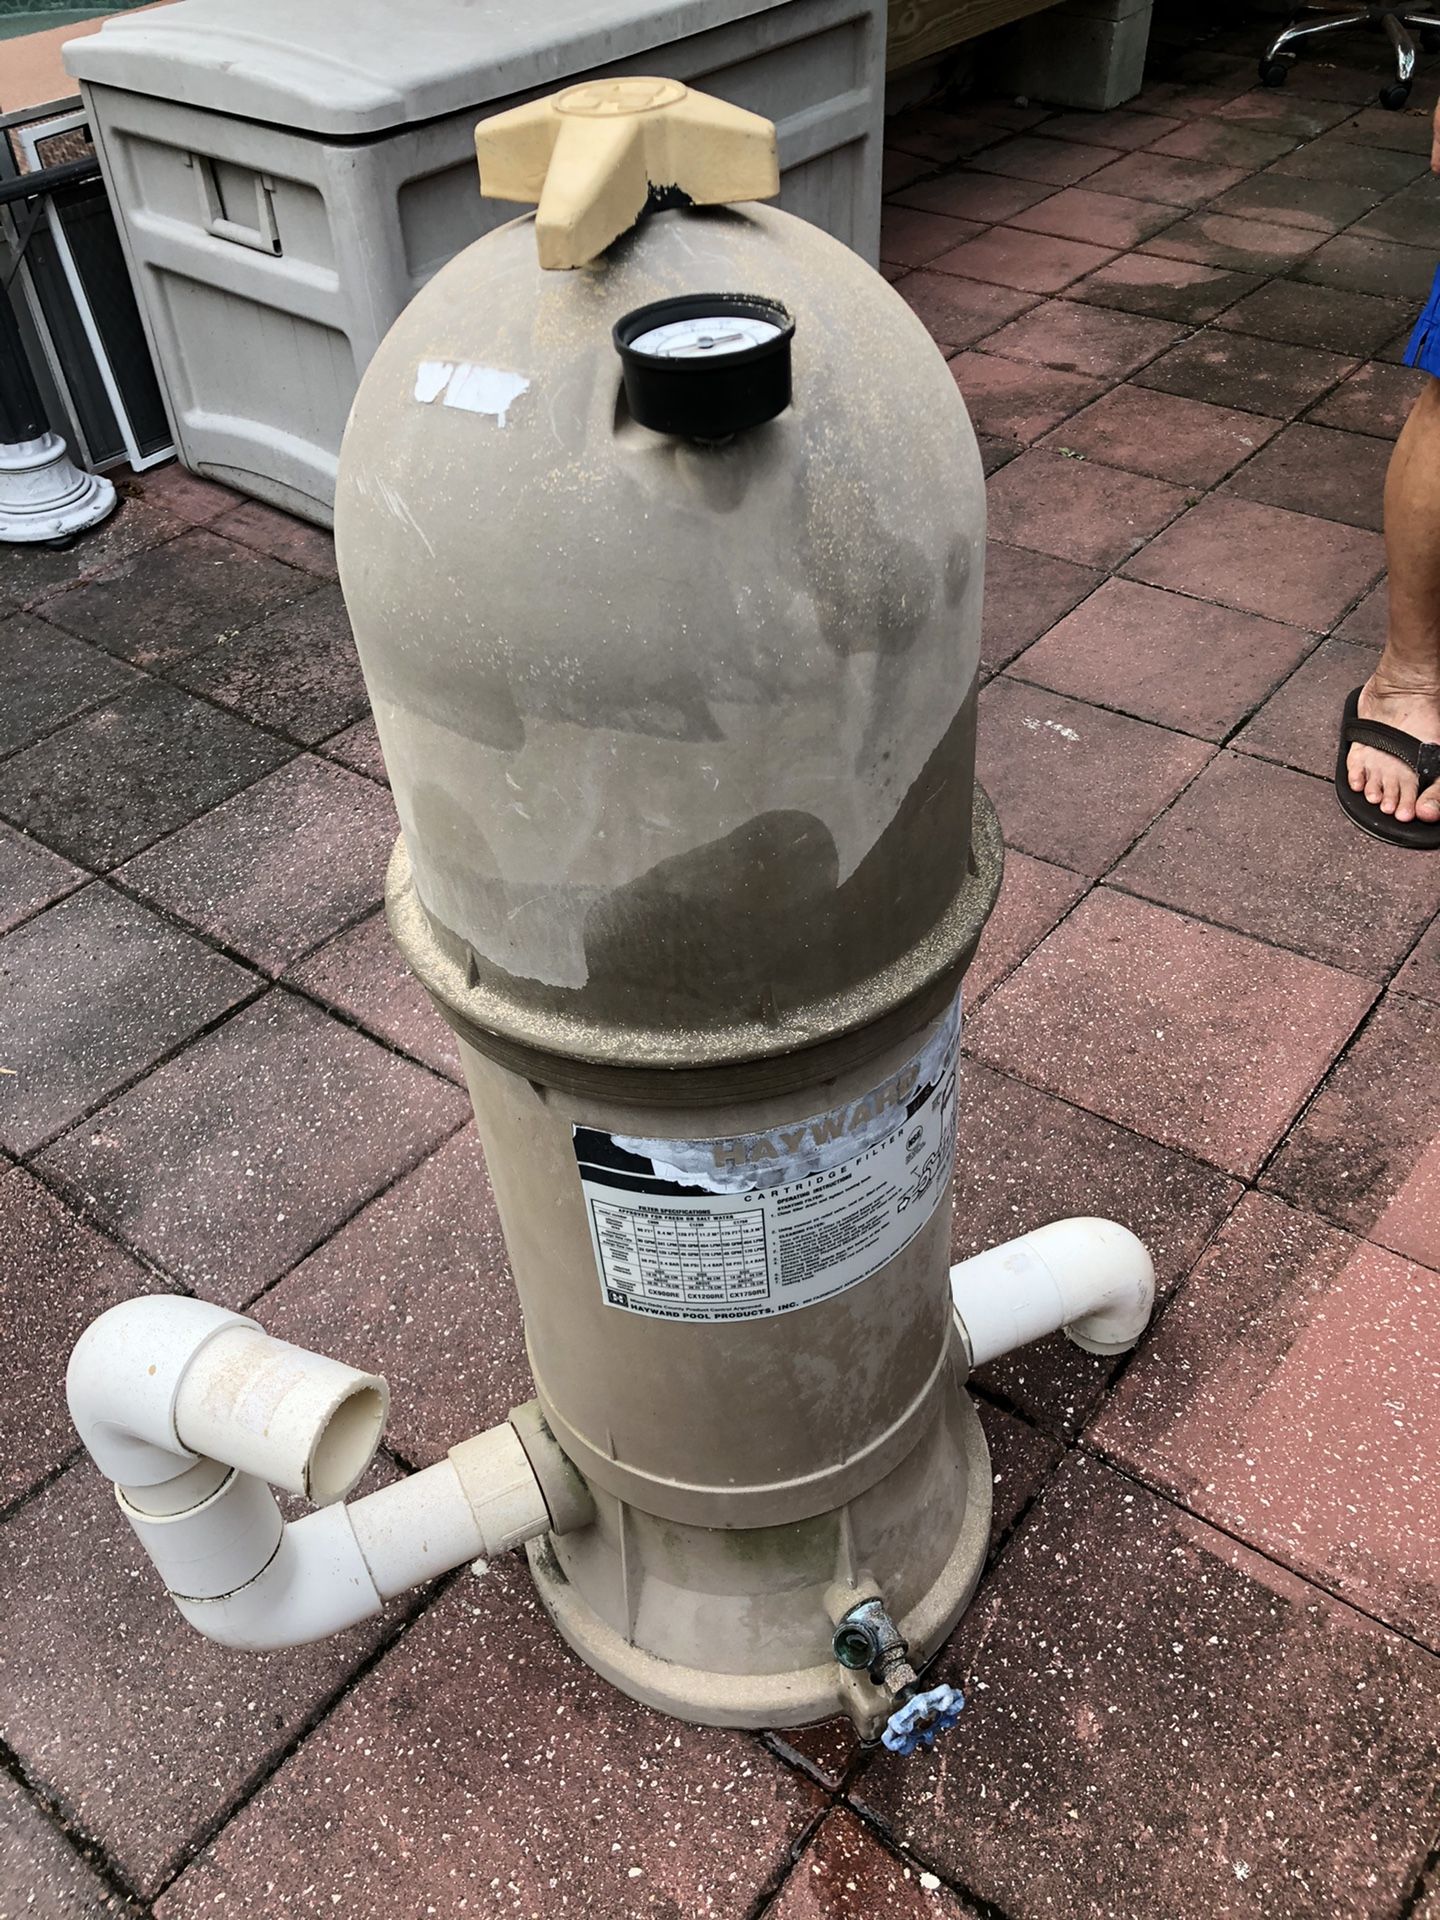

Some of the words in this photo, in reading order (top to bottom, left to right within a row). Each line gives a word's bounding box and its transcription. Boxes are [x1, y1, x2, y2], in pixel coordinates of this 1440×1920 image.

[713, 1062, 920, 1169] HAYWARD
[743, 1165, 848, 1203] CARTRIDGE
[855, 1128, 905, 1167] FILTER
[777, 1191, 810, 1205] OPERATING
[813, 1173, 852, 1194] INSTRUCTIONS
[638, 1205, 659, 1213] FILTER
[660, 1208, 711, 1216] SPECIFICATIONS
[729, 1288, 767, 1298] CX1750RE
[630, 1304, 680, 1318] HAYWARD
[683, 1311, 712, 1319] POOL
[714, 1307, 775, 1319] PRODUCTS,
[778, 1301, 799, 1311] INC.
